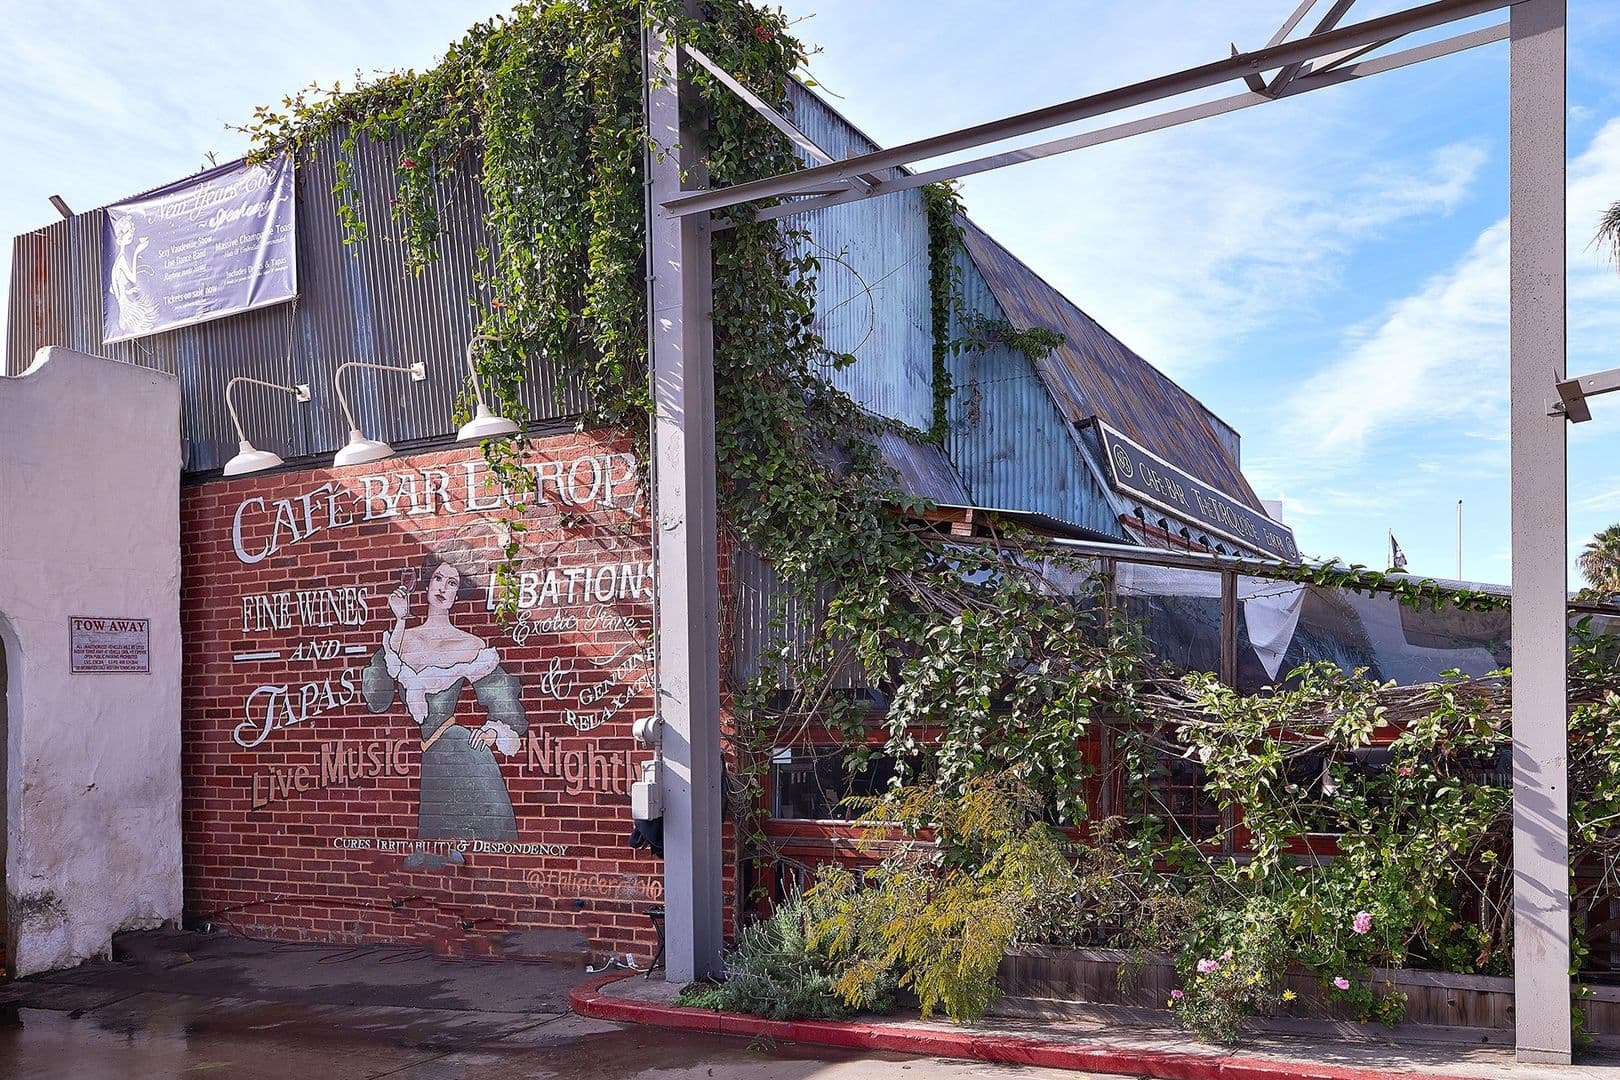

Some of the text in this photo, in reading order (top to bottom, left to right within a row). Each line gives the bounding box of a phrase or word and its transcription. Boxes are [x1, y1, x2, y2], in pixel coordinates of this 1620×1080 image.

[74, 620, 146, 632] TOW AWAY
[242, 587, 369, 632] FINE WINES
[513, 604, 638, 645] Exotic Fare
[288, 639, 341, 661] AND
[541, 656, 575, 700] &
[233, 668, 355, 747] TAPAS
[252, 765, 310, 810] Live
[333, 837, 371, 849] CURES
[456, 840, 470, 851] &
[472, 840, 569, 856] DESPONDENCY
